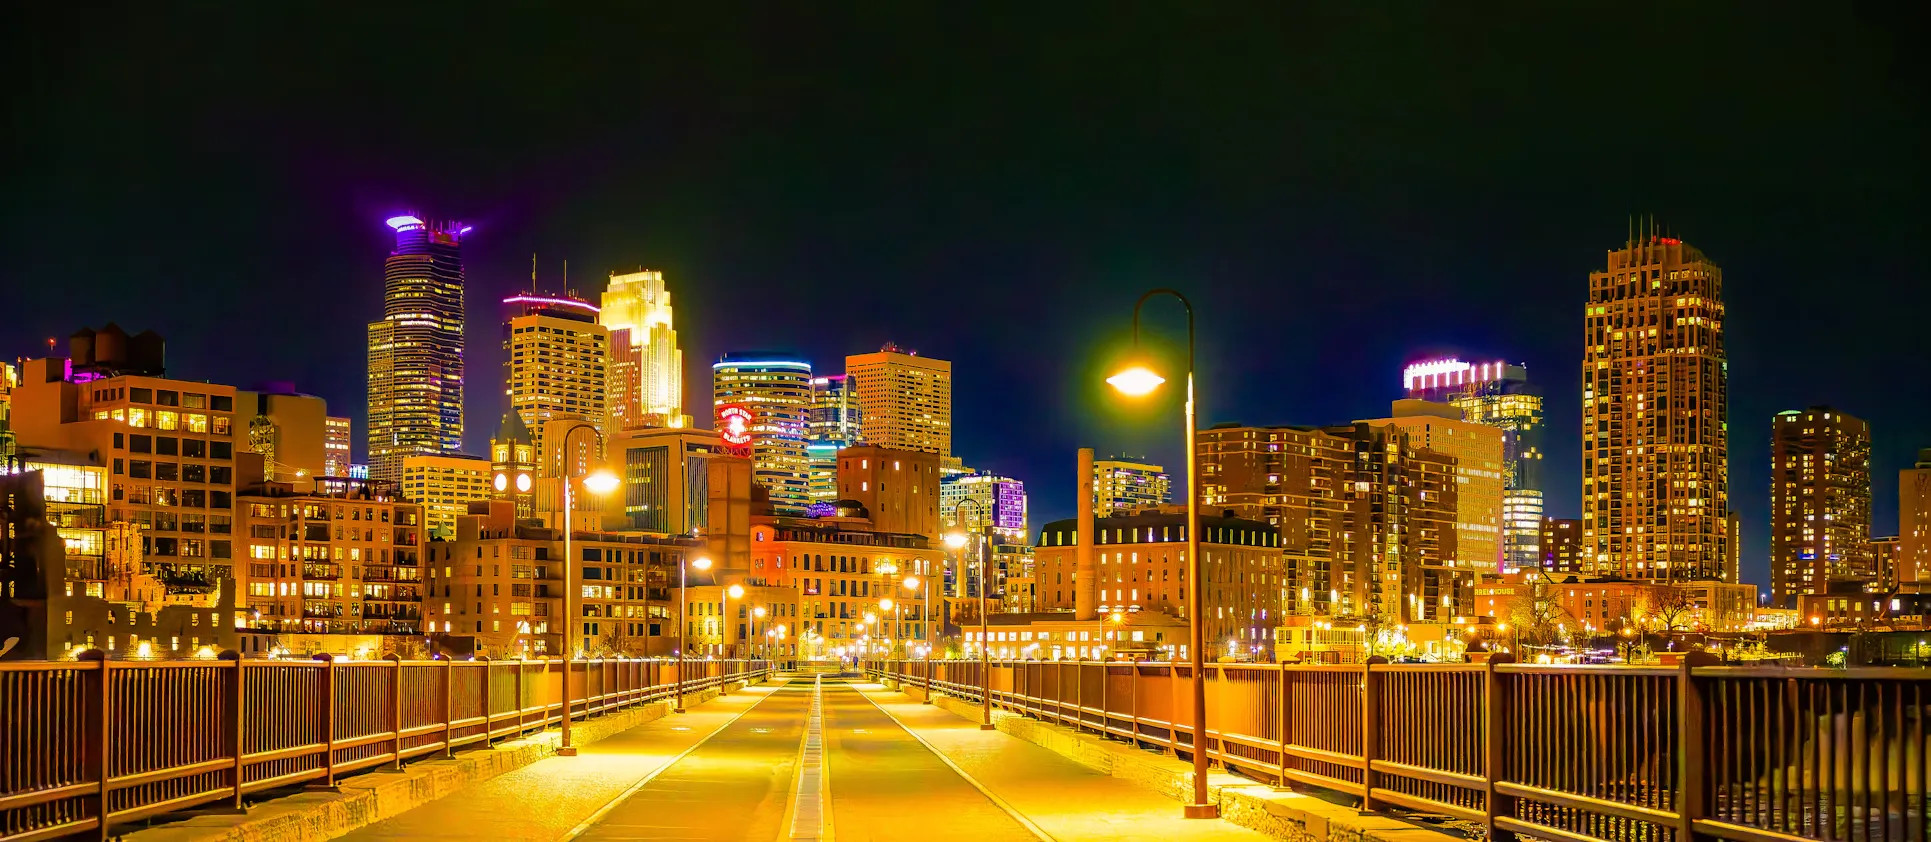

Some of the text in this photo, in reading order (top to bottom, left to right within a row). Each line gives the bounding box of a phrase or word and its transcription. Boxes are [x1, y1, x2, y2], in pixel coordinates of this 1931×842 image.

[721, 407, 752, 421] NORTH STAR
[723, 432, 751, 444] BLANKETS
